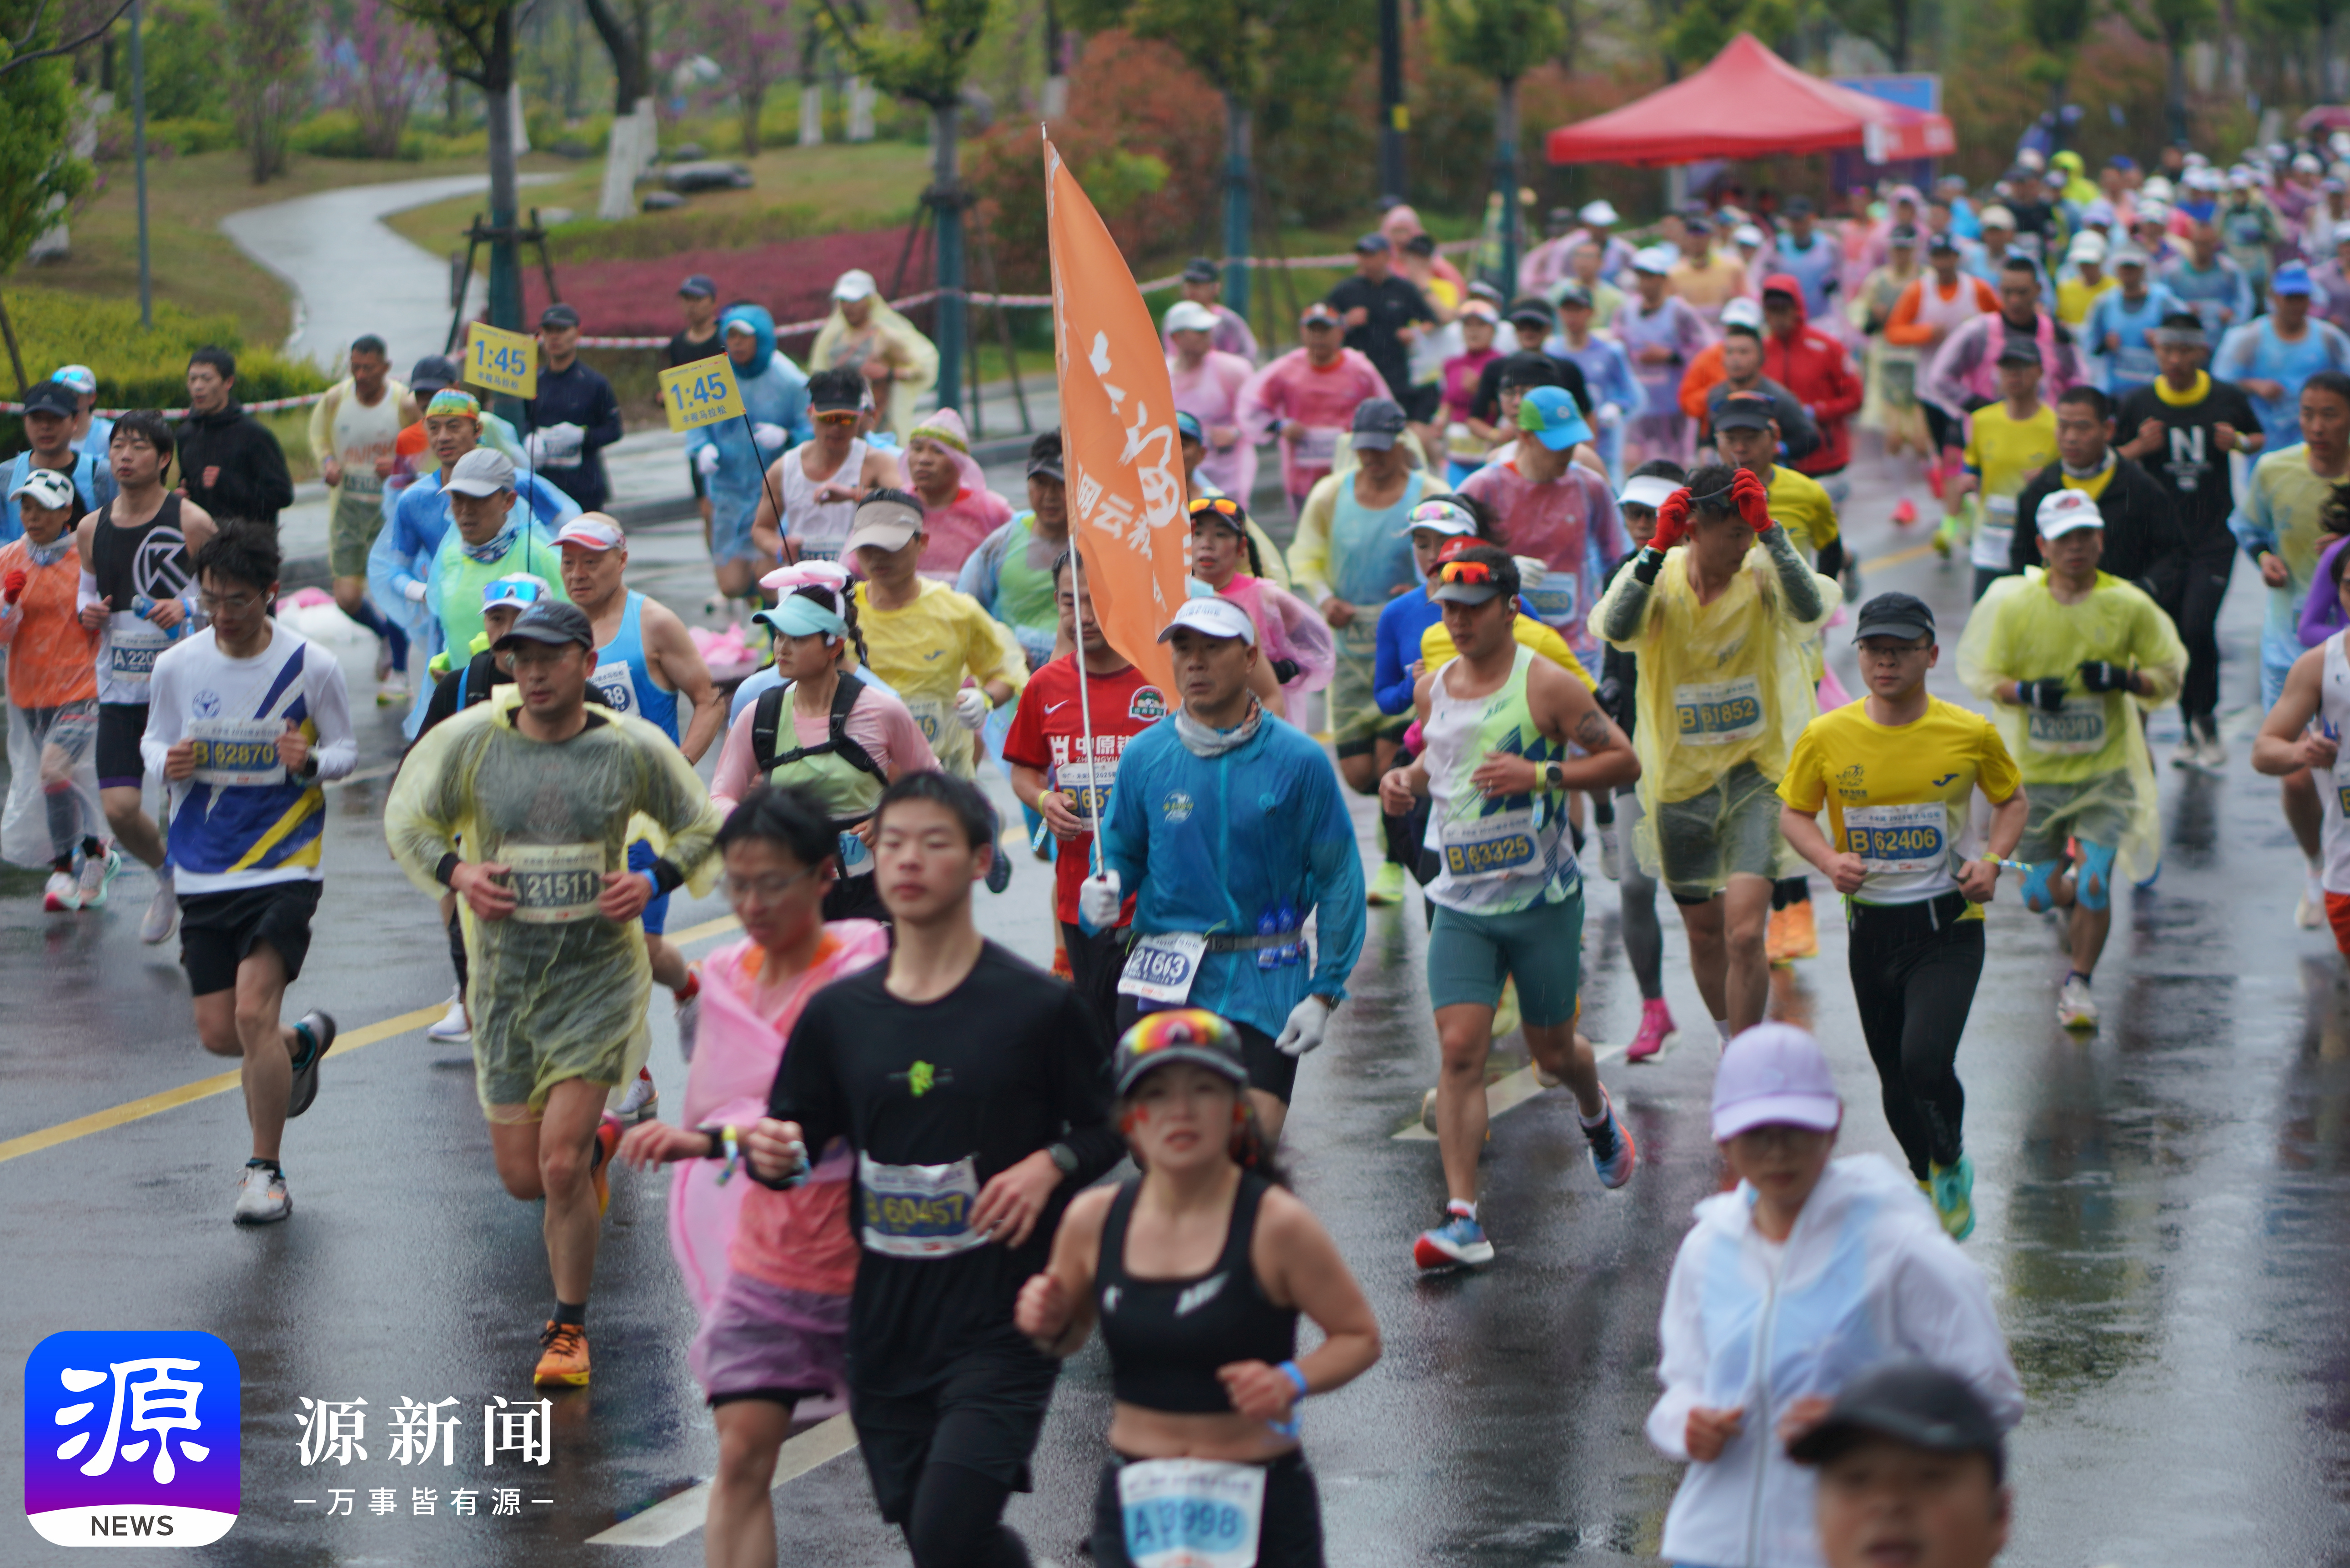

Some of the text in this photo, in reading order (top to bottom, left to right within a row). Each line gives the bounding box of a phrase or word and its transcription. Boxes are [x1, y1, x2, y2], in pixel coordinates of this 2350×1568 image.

[476, 340, 526, 377] 1:45
[670, 372, 727, 411] 1:45
[683, 405, 727, 424] 半程马拉松
[2169, 425, 2206, 462] N
[114, 649, 126, 668] A
[1678, 699, 1756, 728] B 61852
[215, 742, 275, 765] 62870
[1448, 835, 1529, 871] B 63325
[1850, 828, 1937, 852] B 62406
[527, 871, 592, 899] 21511
[883, 1193, 964, 1225] 60457
